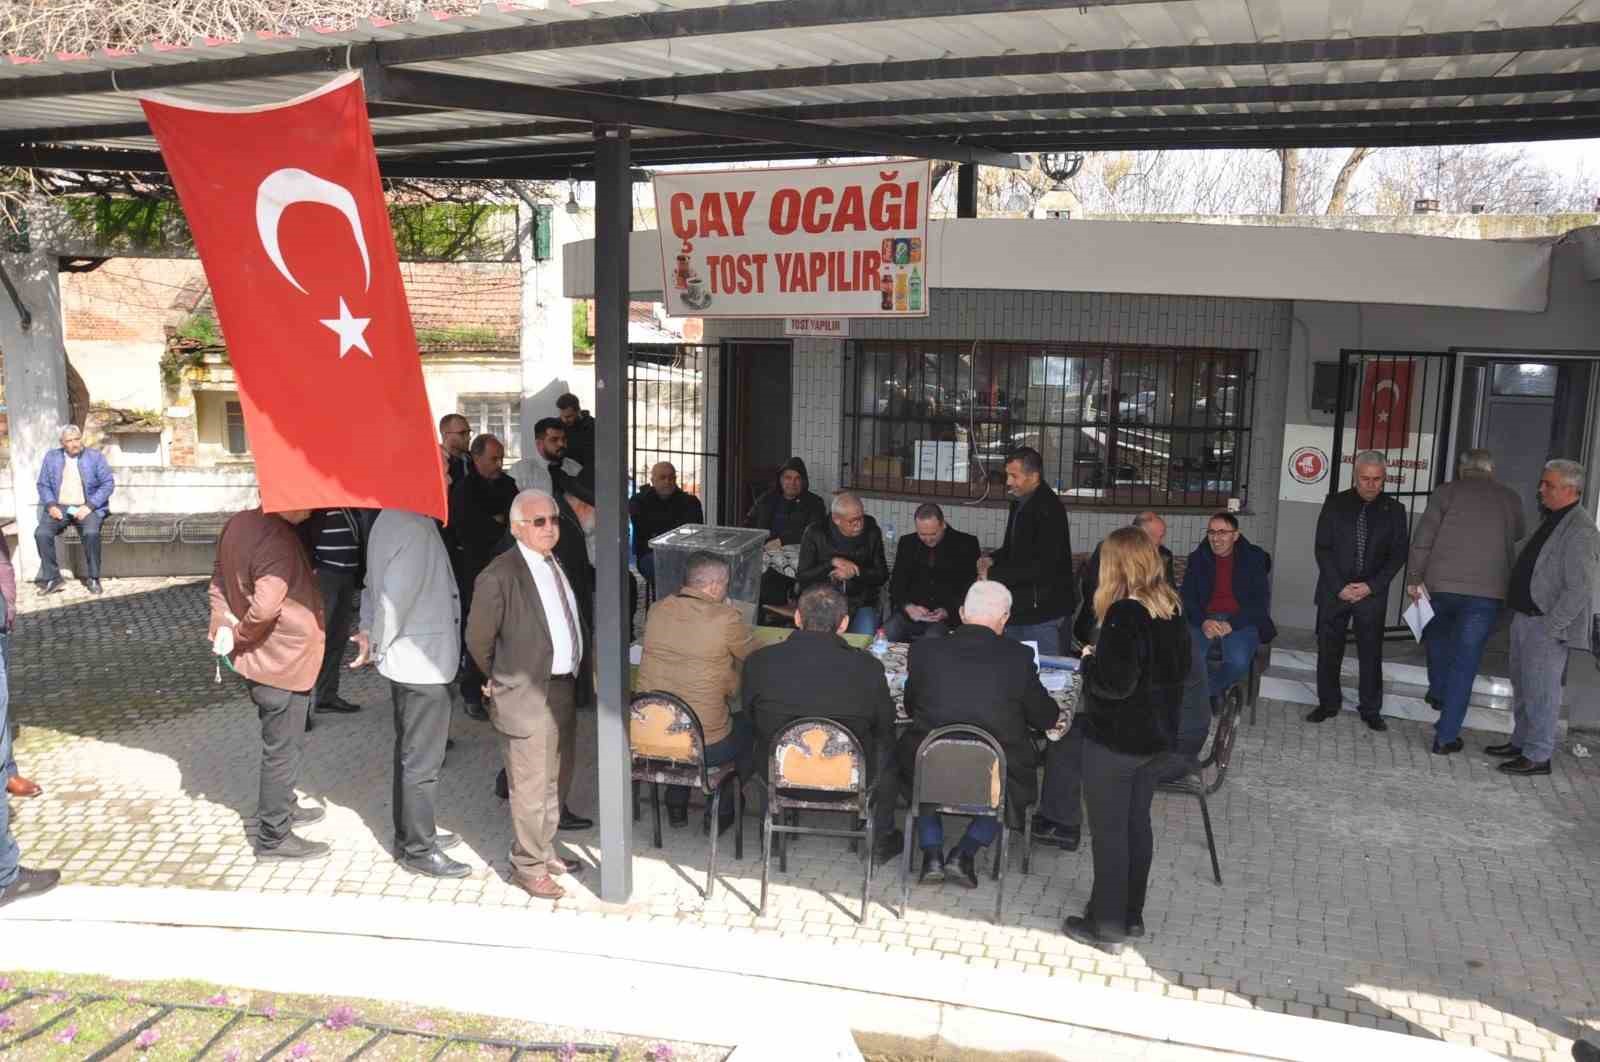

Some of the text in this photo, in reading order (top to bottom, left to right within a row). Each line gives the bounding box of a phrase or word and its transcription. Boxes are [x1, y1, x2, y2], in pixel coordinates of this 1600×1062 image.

[670, 170, 920, 254] ÇAY OCAĞI
[706, 253, 769, 295] TOST
[775, 249, 882, 293] YAPILIR
